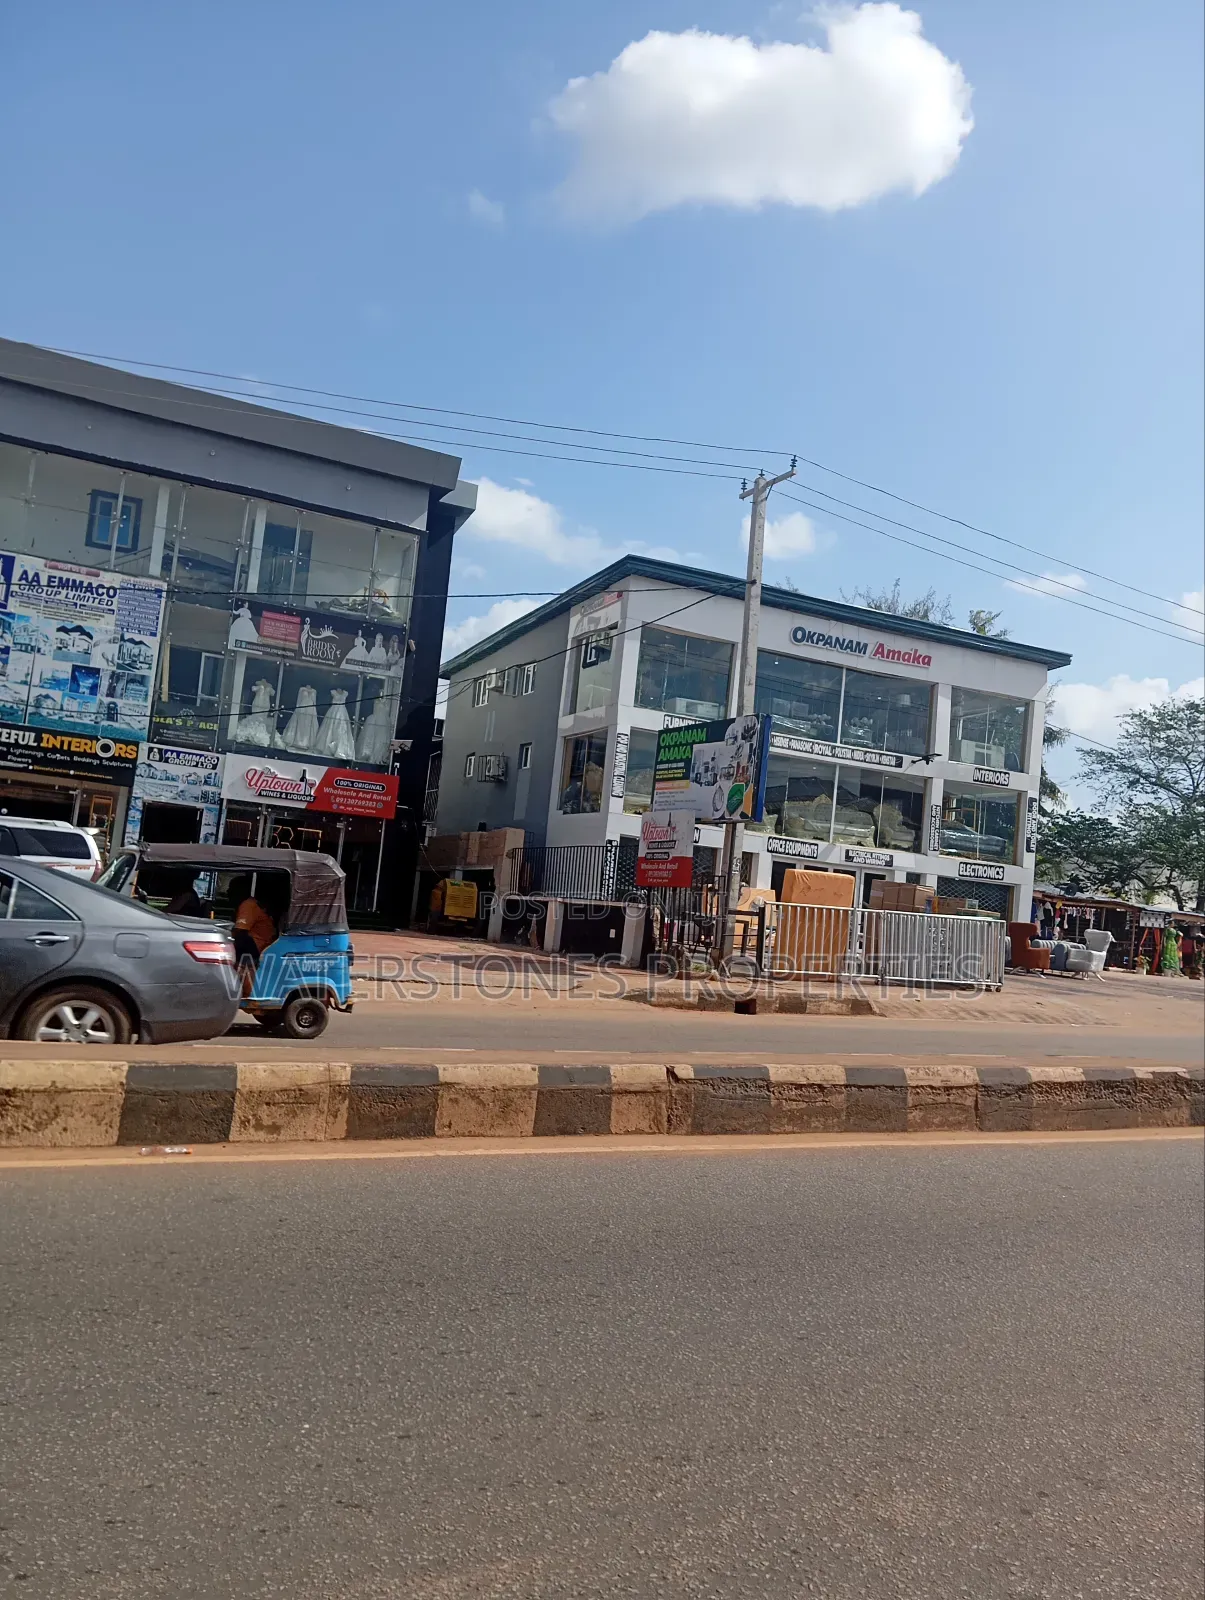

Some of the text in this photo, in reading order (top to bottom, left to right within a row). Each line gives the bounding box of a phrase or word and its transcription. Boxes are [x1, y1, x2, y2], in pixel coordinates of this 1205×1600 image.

[18, 570, 118, 599] AA EMMACO
[18, 584, 62, 597] GROUP
[64, 592, 114, 607] LIMITED
[308, 639, 337, 652] BRIDES
[792, 626, 932, 666] OKPANAM Amaka
[307, 648, 335, 660] ROOM
[660, 728, 707, 746] OKPANAM
[40, 733, 138, 759] INTERIORS
[658, 745, 692, 762] AMAKA
[814, 743, 832, 756] ROYAL
[7, 755, 32, 763] Flowers
[47, 753, 70, 761] Carpets
[74, 756, 100, 765] Beddings
[102, 760, 133, 768] Sculptures
[168, 758, 196, 766] GROUP
[180, 753, 217, 764] EMMACO
[246, 768, 303, 795] Uptown
[974, 768, 1009, 785] INTERIORS
[324, 787, 357, 796] Wholesale
[353, 782, 383, 790] ORIGINAL
[768, 838, 818, 858] OFFICE EQUIPMENTS
[866, 858, 886, 866] WIRING
[959, 862, 1004, 880] ELECTRONICS
